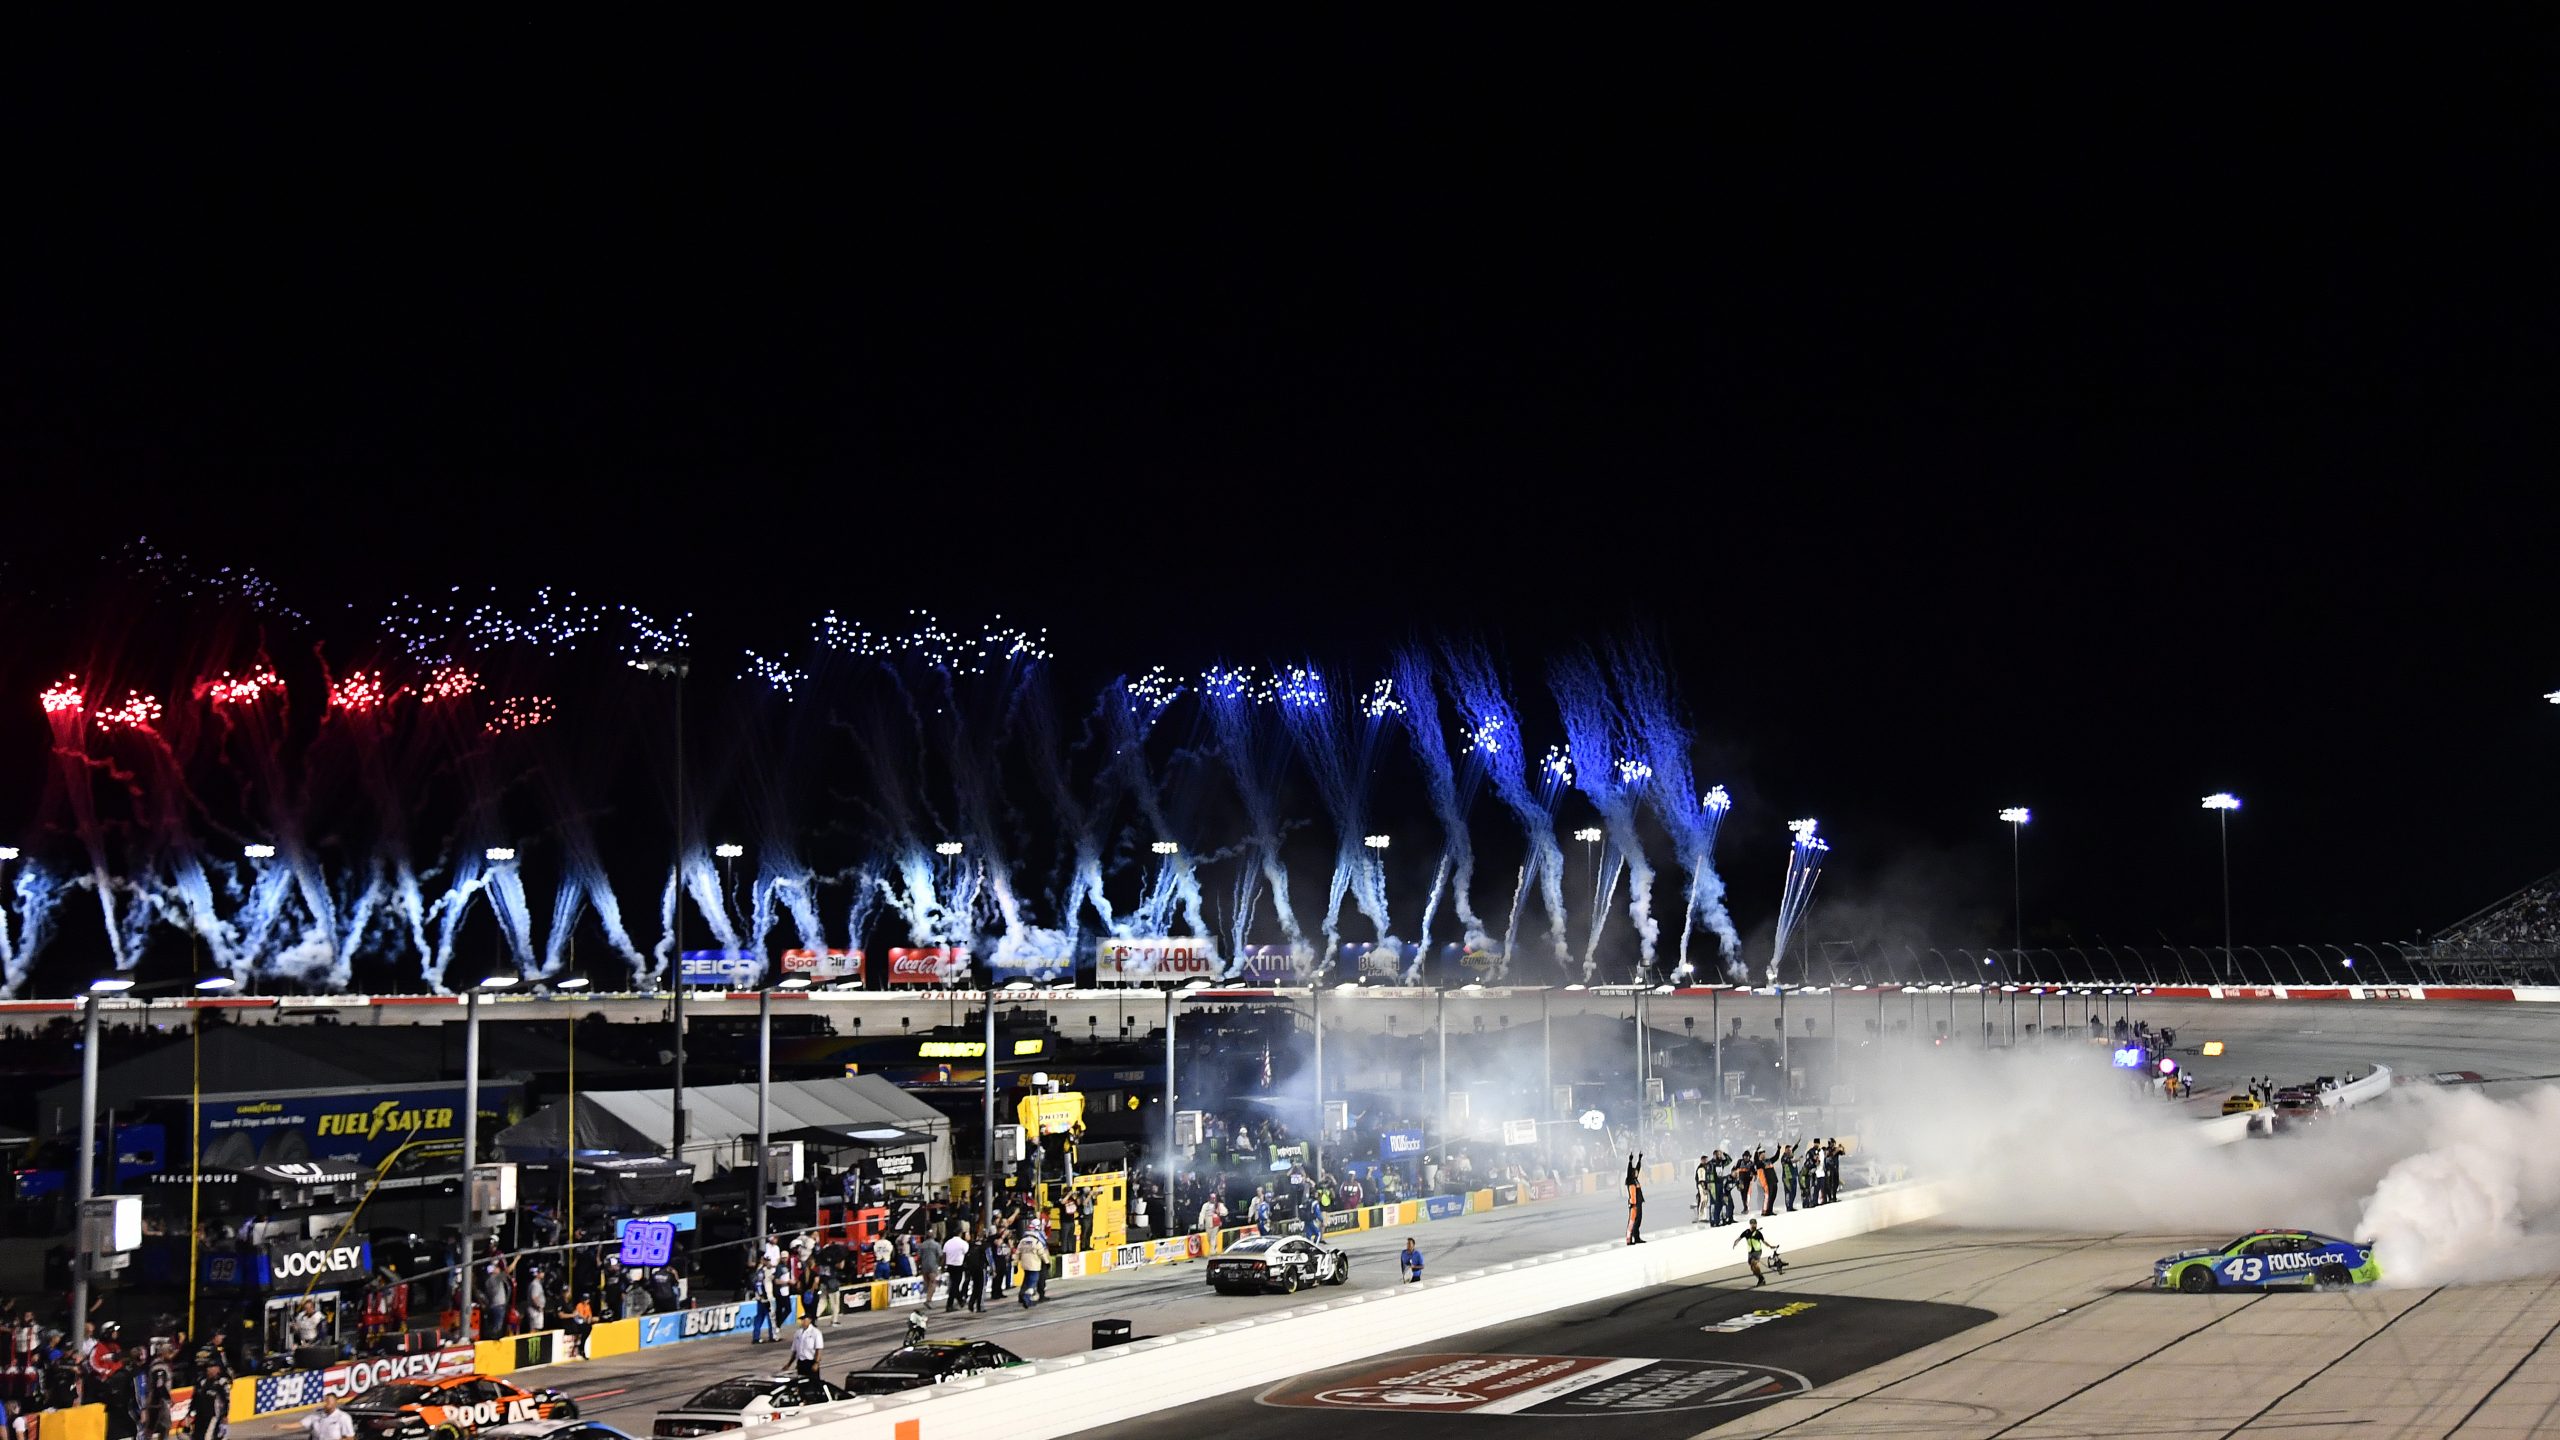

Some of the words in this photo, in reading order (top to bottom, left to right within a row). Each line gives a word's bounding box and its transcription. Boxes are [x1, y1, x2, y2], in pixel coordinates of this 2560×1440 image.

[918, 1041, 987, 1058] SUNOCO
[316, 1113, 369, 1137] FUEL
[384, 1107, 454, 1132] SAVER
[893, 1202, 921, 1231] 7
[273, 1245, 361, 1279] JOCKEY
[1314, 1253, 1332, 1277] 14
[2223, 1257, 2263, 1282] 43
[645, 1316, 662, 1343] 7
[332, 1350, 442, 1396] JOCKEY
[274, 1375, 305, 1408] 99
[507, 1397, 541, 1424] 45
